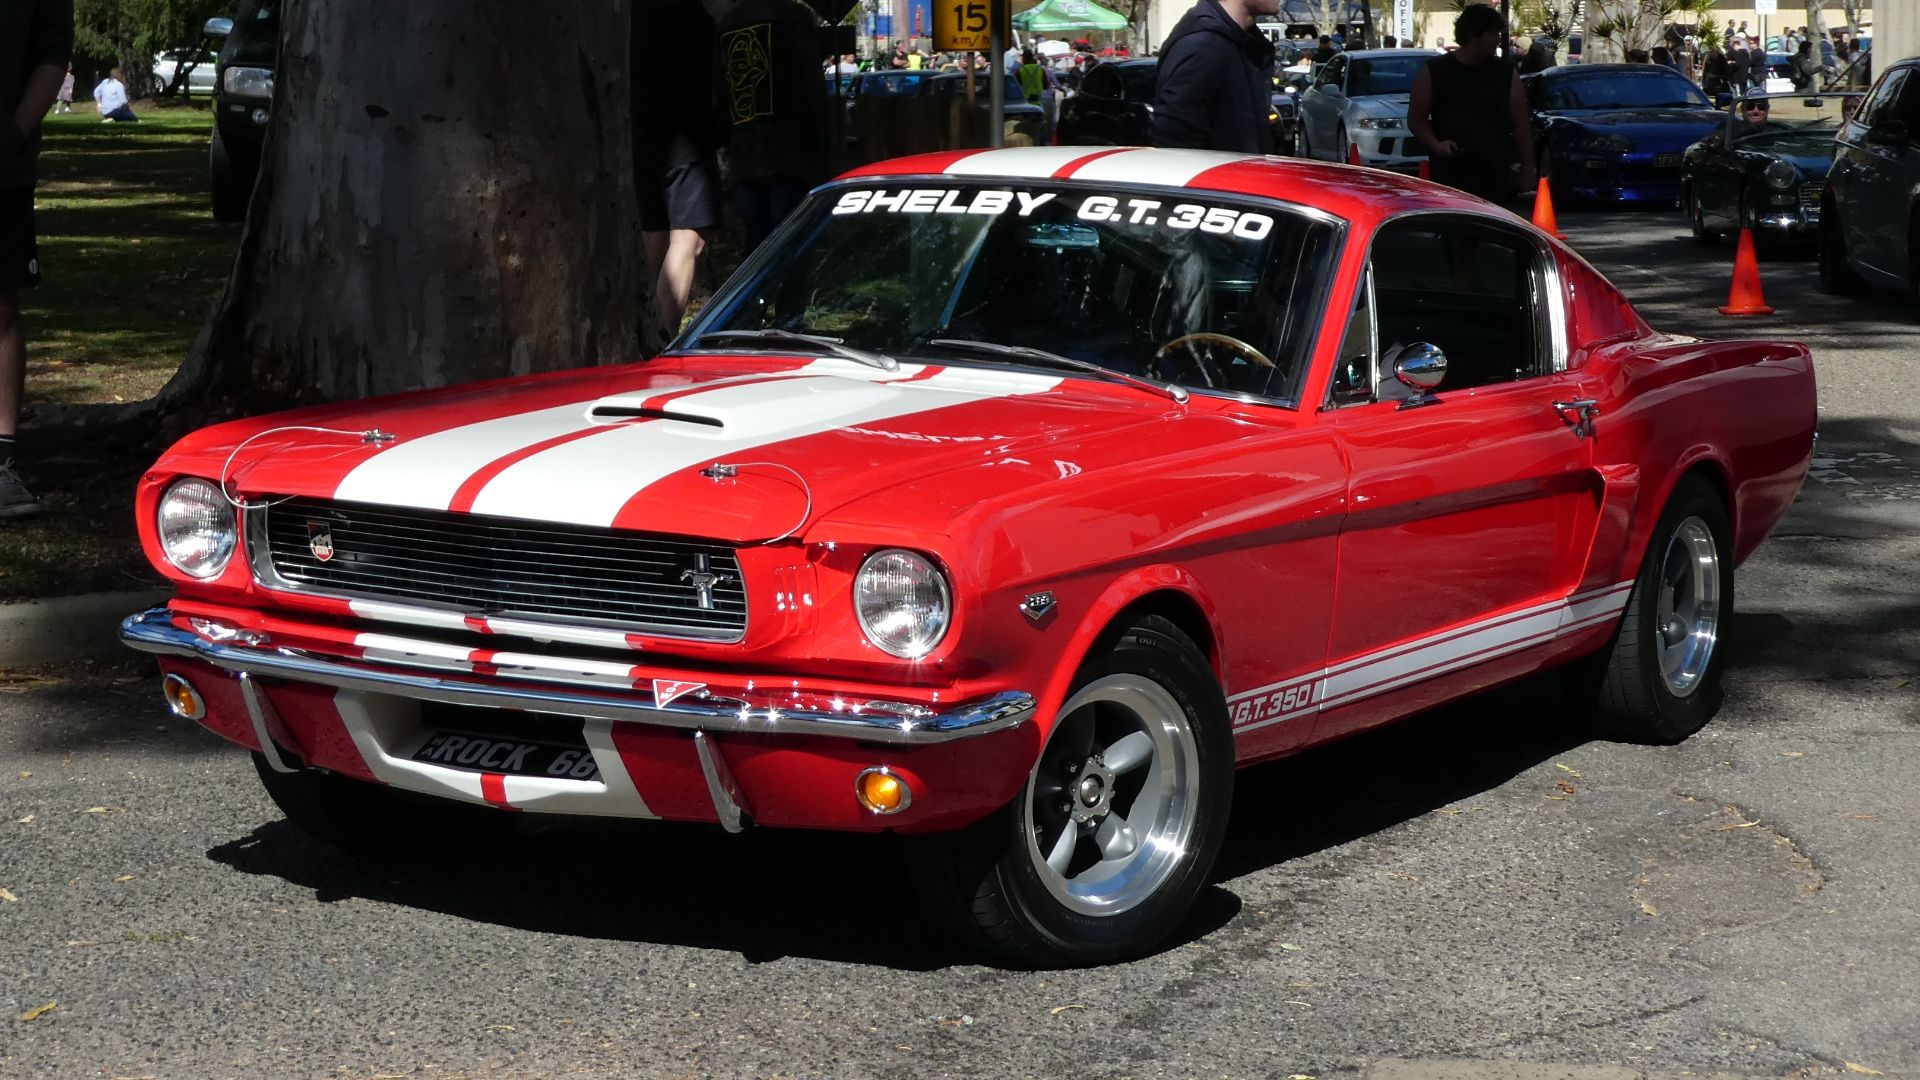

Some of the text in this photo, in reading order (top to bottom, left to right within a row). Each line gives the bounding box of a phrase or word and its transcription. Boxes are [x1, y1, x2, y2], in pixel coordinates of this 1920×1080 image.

[954, 2, 987, 32] 15
[832, 190, 1274, 240] SHELBY G.T. 350
[432, 736, 597, 777] ROCK 66
